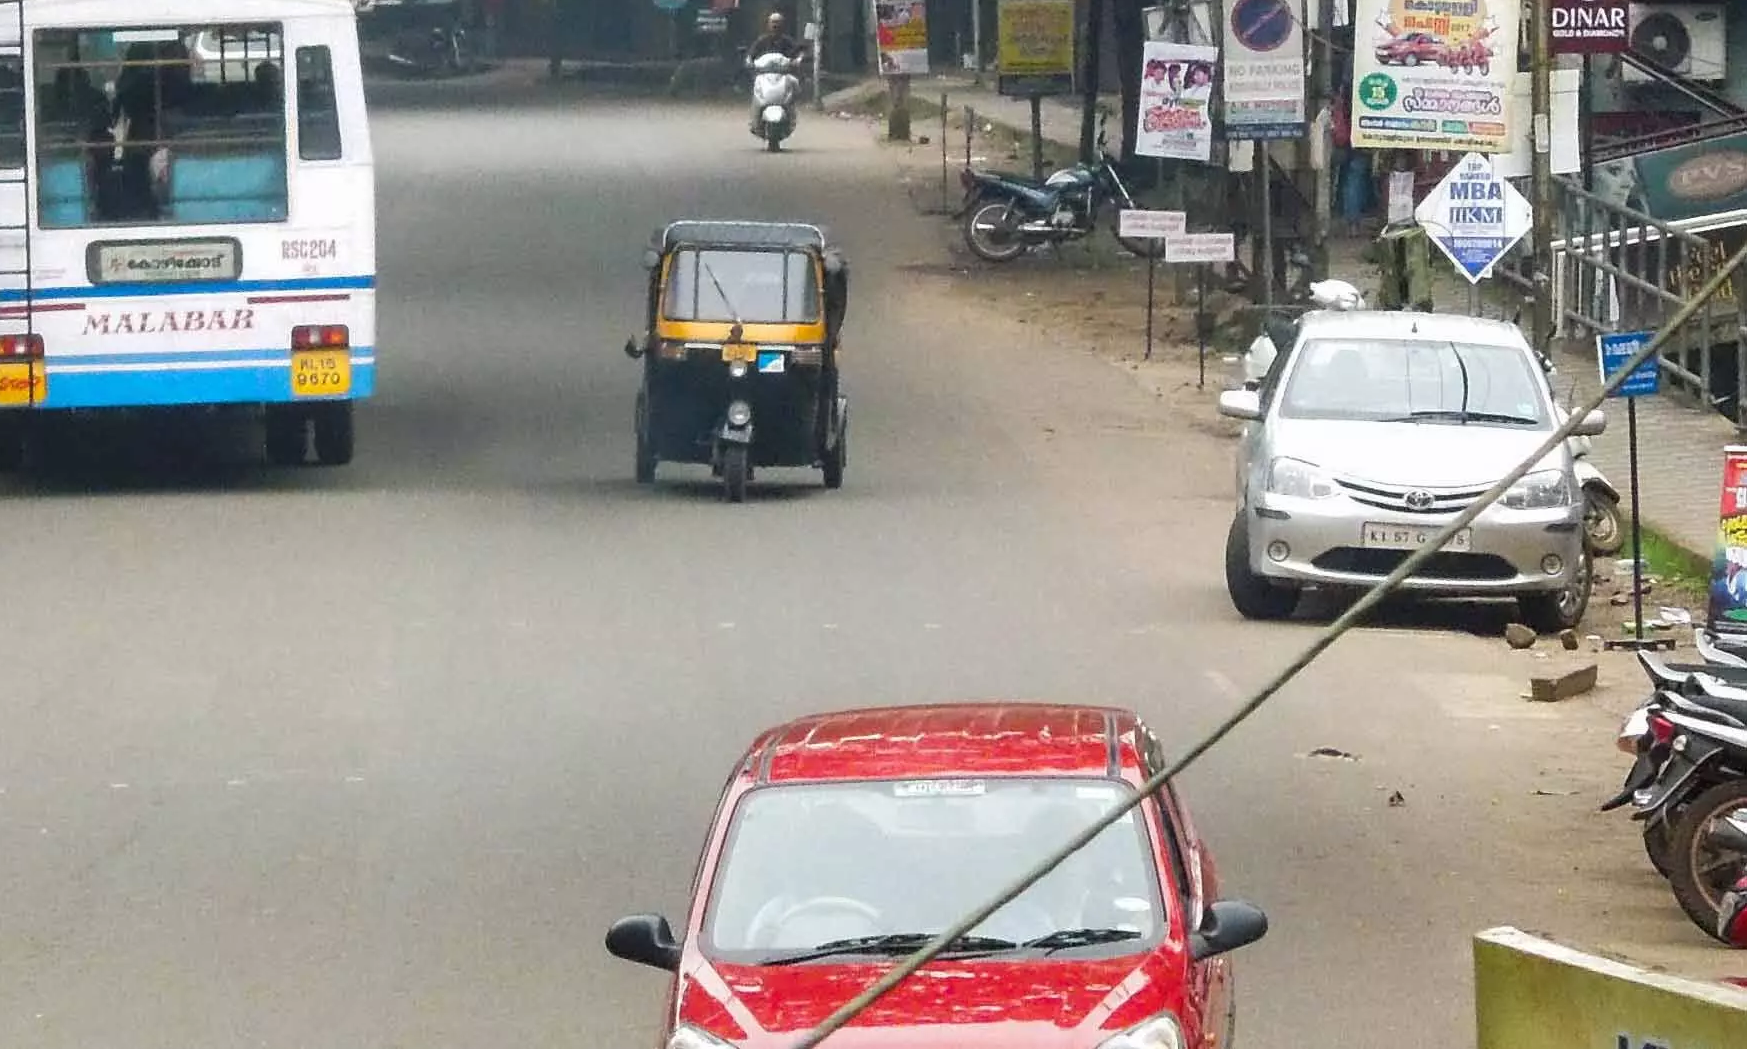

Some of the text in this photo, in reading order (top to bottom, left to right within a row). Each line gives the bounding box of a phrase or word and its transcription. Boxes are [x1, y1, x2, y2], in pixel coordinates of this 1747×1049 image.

[1552, 7, 1626, 27] DINAR
[1553, 28, 1574, 37] GOLD
[1250, 63, 1301, 76] PARKING
[1450, 183, 1501, 200] MBA
[1449, 207, 1502, 224] IIKM
[82, 308, 256, 336] MALABAR
